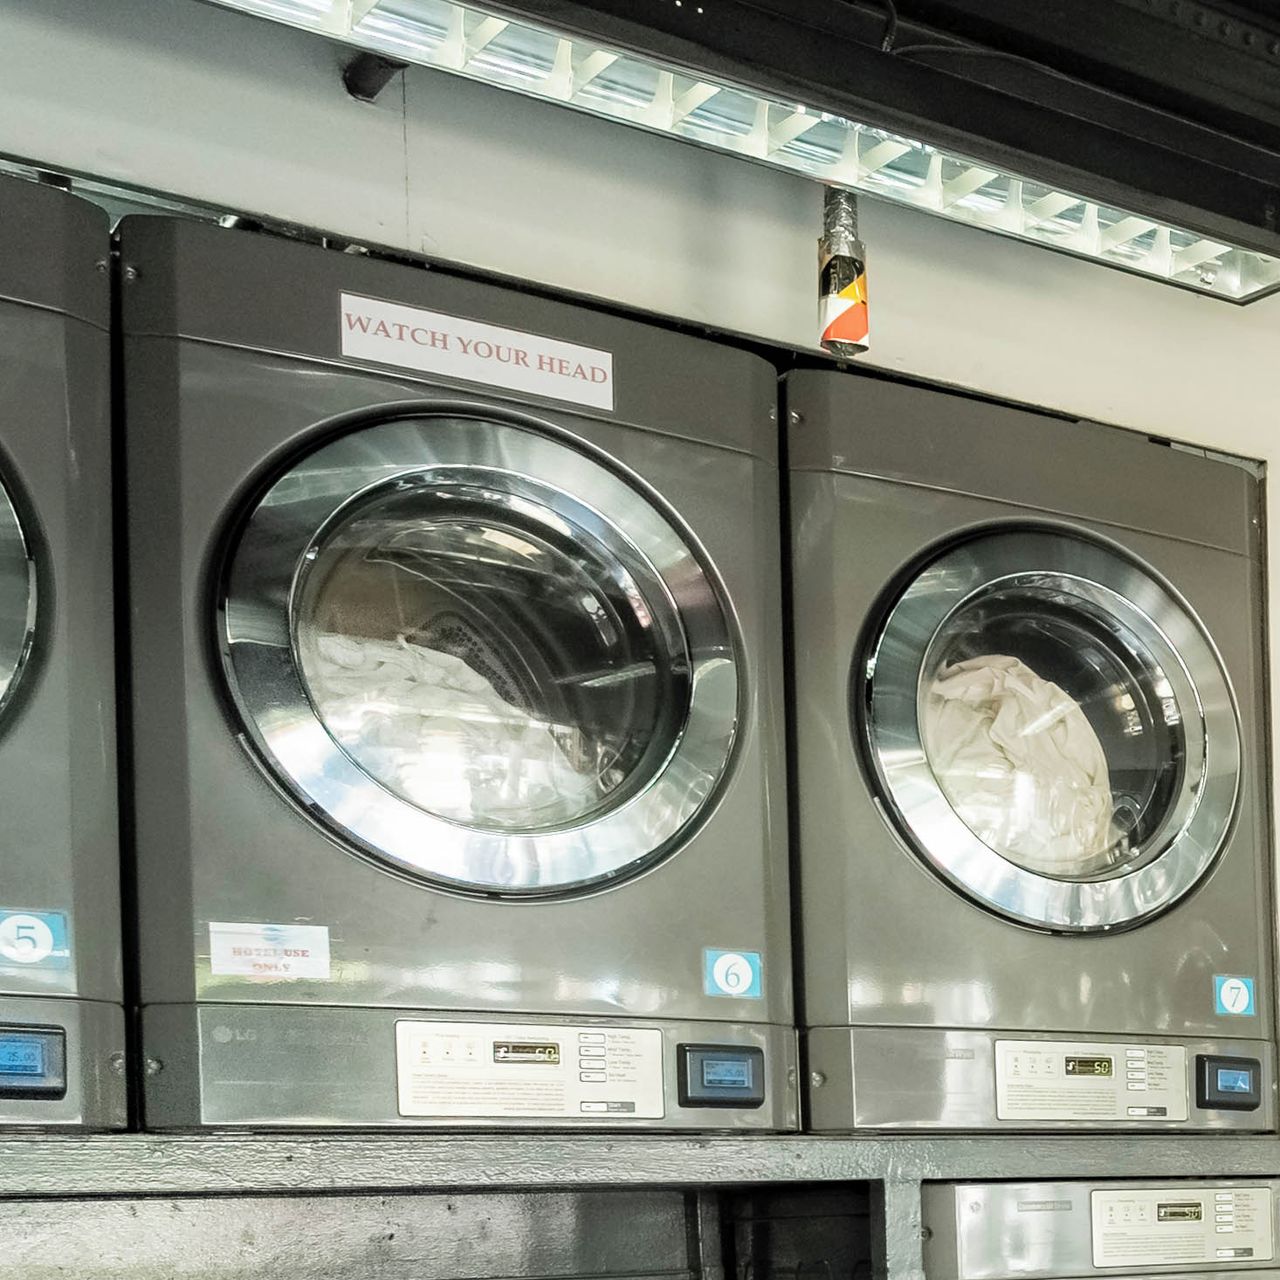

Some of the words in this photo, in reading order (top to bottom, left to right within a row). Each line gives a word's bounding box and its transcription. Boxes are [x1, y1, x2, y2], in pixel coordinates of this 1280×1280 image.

[345, 313, 448, 350] WATCH
[457, 336, 530, 368] YOUR
[537, 354, 609, 384] HEAD
[16, 925, 36, 949] 5
[284, 949, 309, 958] USE
[725, 962, 740, 987] 6
[1229, 986, 1242, 1008] 7
[1094, 1061, 1109, 1074] 50
